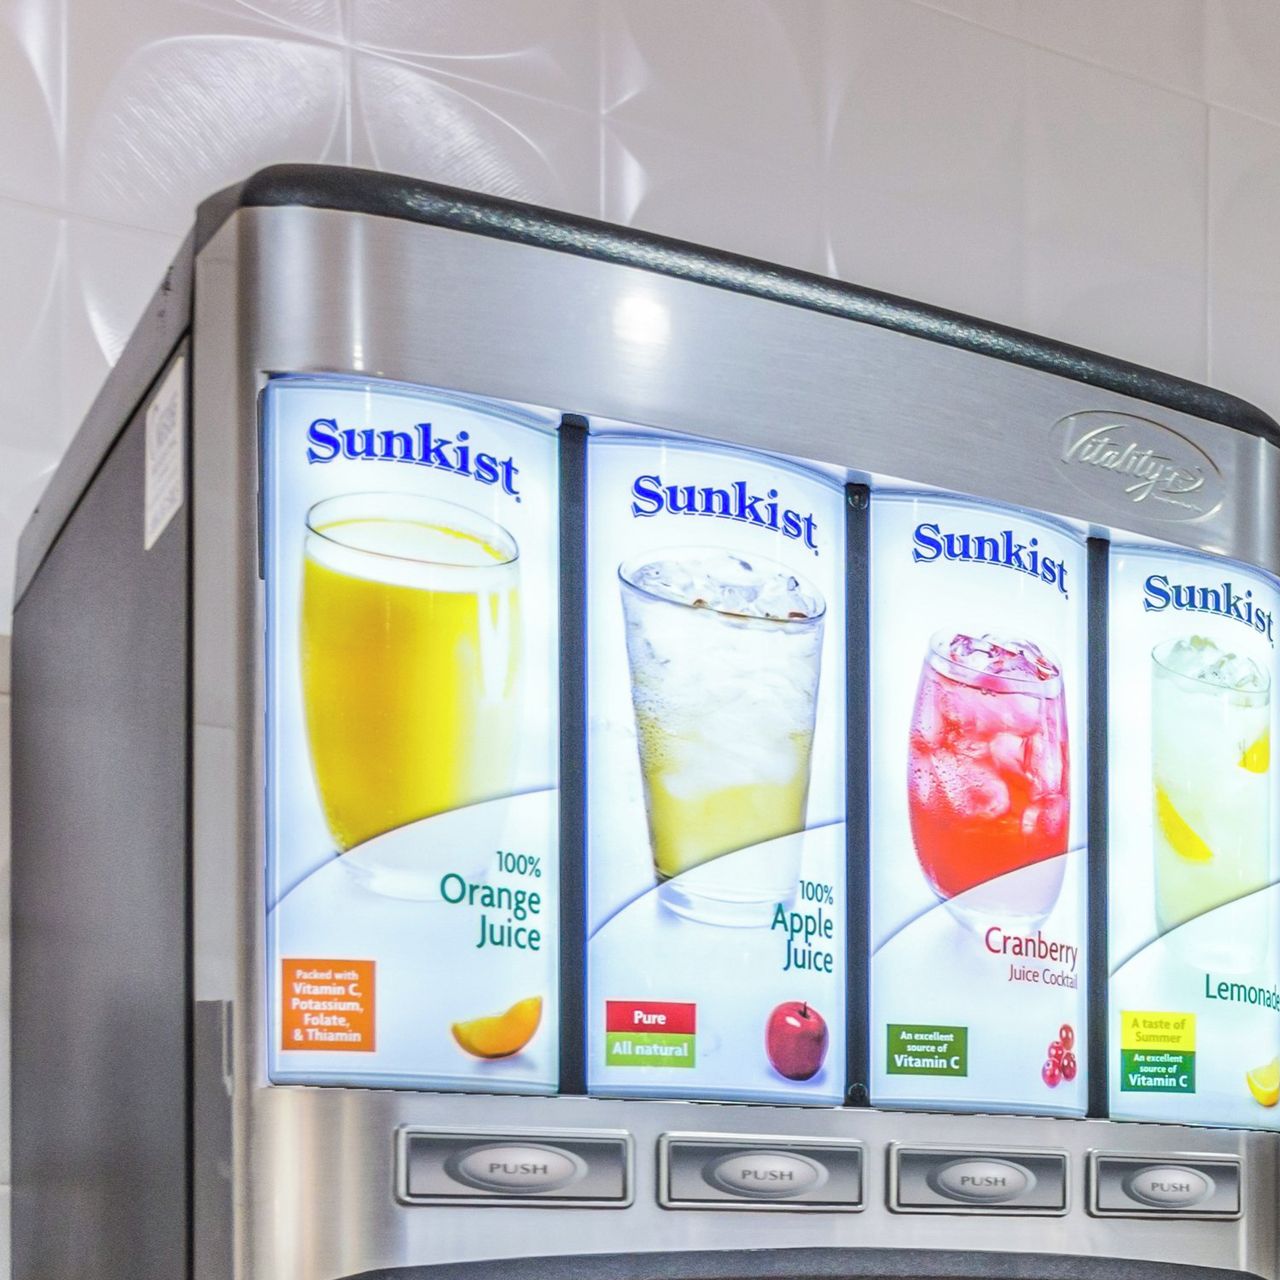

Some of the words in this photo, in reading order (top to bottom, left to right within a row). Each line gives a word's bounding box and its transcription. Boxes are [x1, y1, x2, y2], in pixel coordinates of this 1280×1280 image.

[307, 418, 520, 497] Sunkist
[631, 475, 818, 550] Sunkist
[913, 523, 1068, 594] Sunkist
[1144, 575, 1274, 643] Sunkist
[496, 851, 542, 878] 100%
[440, 873, 542, 921] Orange
[800, 880, 834, 905] 100%
[771, 903, 834, 944] Apple
[476, 915, 542, 951] Juice
[783, 939, 834, 974] Juice
[985, 927, 1078, 972] Cranberry
[295, 969, 333, 981] Packed
[334, 969, 359, 981] with
[1008, 964, 1040, 983] Juice
[293, 983, 345, 996] Vitamin
[347, 984, 362, 997] C,
[1205, 973, 1280, 1012] Lemonade
[291, 998, 364, 1013] Potassium,
[303, 1013, 351, 1028] Folate,
[633, 1010, 667, 1025] Pure
[1131, 1018, 1140, 1029] A
[1142, 1019, 1171, 1030] taste
[1173, 1019, 1187, 1030] of
[294, 1029, 303, 1042] &
[306, 1029, 362, 1043] Thiamin
[900, 1031, 913, 1041] An
[914, 1032, 955, 1042] excellent
[1135, 1032, 1182, 1043] Summer
[612, 1041, 633, 1056] All
[635, 1042, 689, 1057] natural
[906, 1045, 935, 1053] source
[937, 1043, 948, 1053] of
[894, 1054, 947, 1069] Vitamin
[950, 1056, 960, 1070] C
[1133, 1053, 1145, 1062] An
[1146, 1054, 1183, 1063] excellent
[1140, 1065, 1166, 1073] source
[1167, 1064, 1177, 1073] of
[1128, 1074, 1177, 1087] Vitamin
[1179, 1075, 1188, 1088] C
[488, 1162, 549, 1176] PUSH
[741, 1168, 794, 1181] PUSH
[960, 1175, 1007, 1188] PUSH
[1150, 1181, 1191, 1193] PUSH
